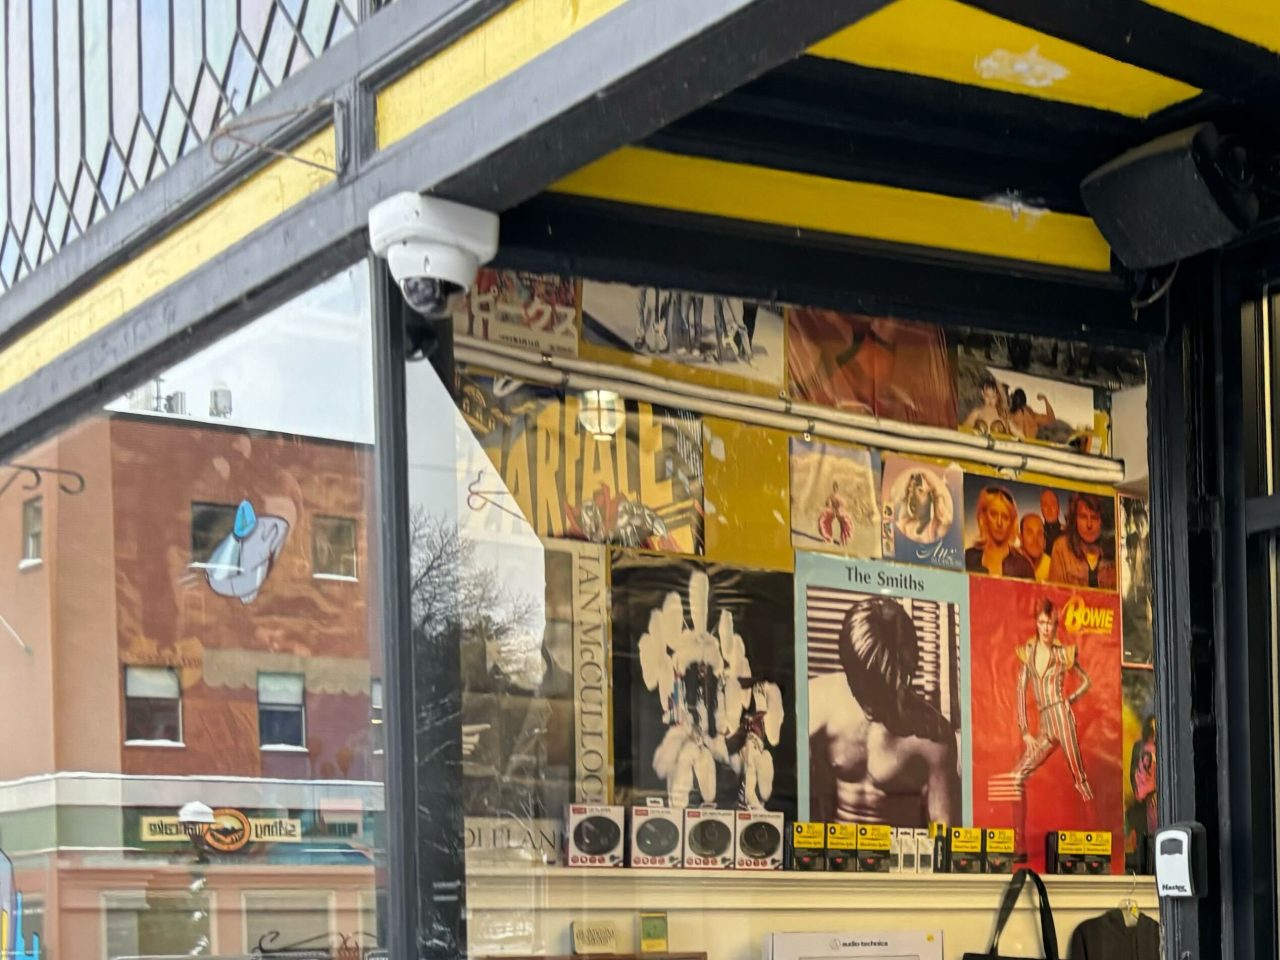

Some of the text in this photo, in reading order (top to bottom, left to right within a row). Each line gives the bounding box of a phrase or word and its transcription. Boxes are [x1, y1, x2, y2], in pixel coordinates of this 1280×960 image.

[577, 551, 601, 615] IAN
[845, 565, 925, 592] The Smiths
[579, 620, 605, 805] McCULLOC
